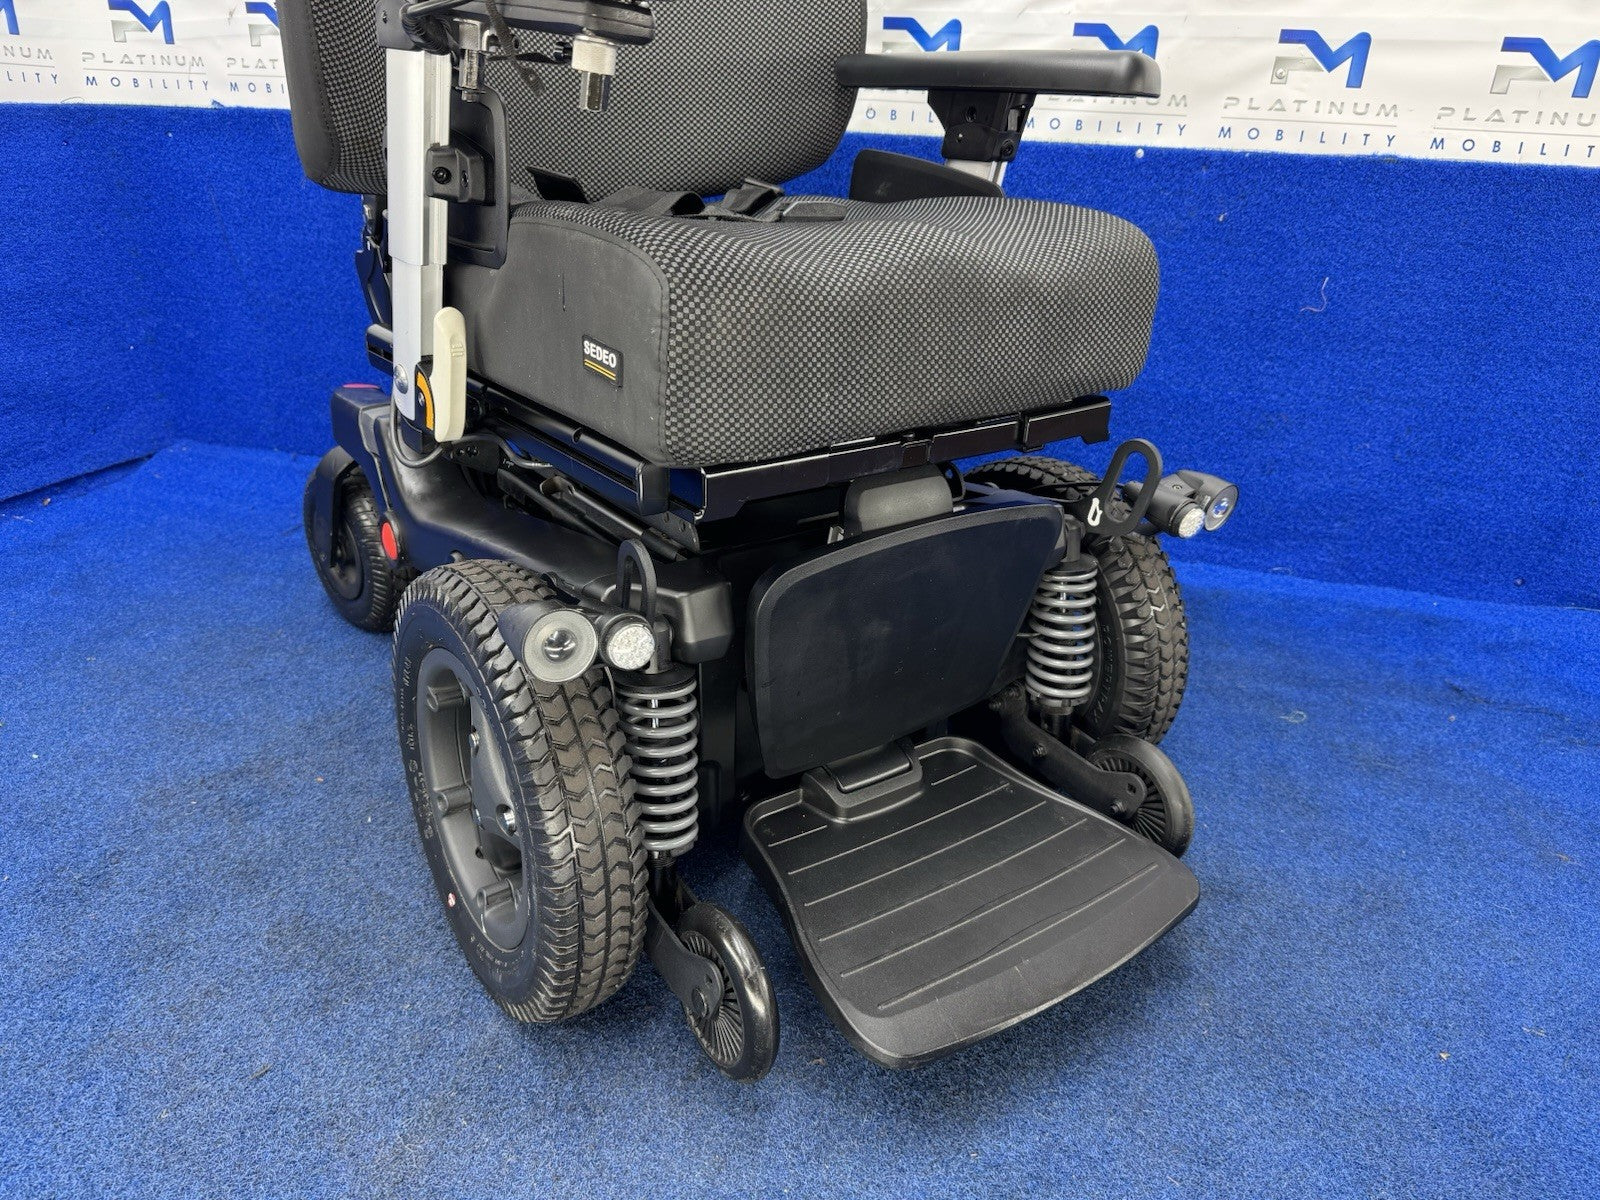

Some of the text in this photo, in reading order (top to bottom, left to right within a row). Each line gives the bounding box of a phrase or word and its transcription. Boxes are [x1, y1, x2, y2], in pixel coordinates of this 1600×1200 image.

[81, 51, 206, 68] PLATINUM
[85, 75, 209, 91] MOBILITY
[1223, 96, 1399, 118] PLATINUM
[1025, 116, 1187, 136] MOBILITY
[1217, 126, 1396, 147] MOBILITY
[583, 340, 617, 368] SEDEO
